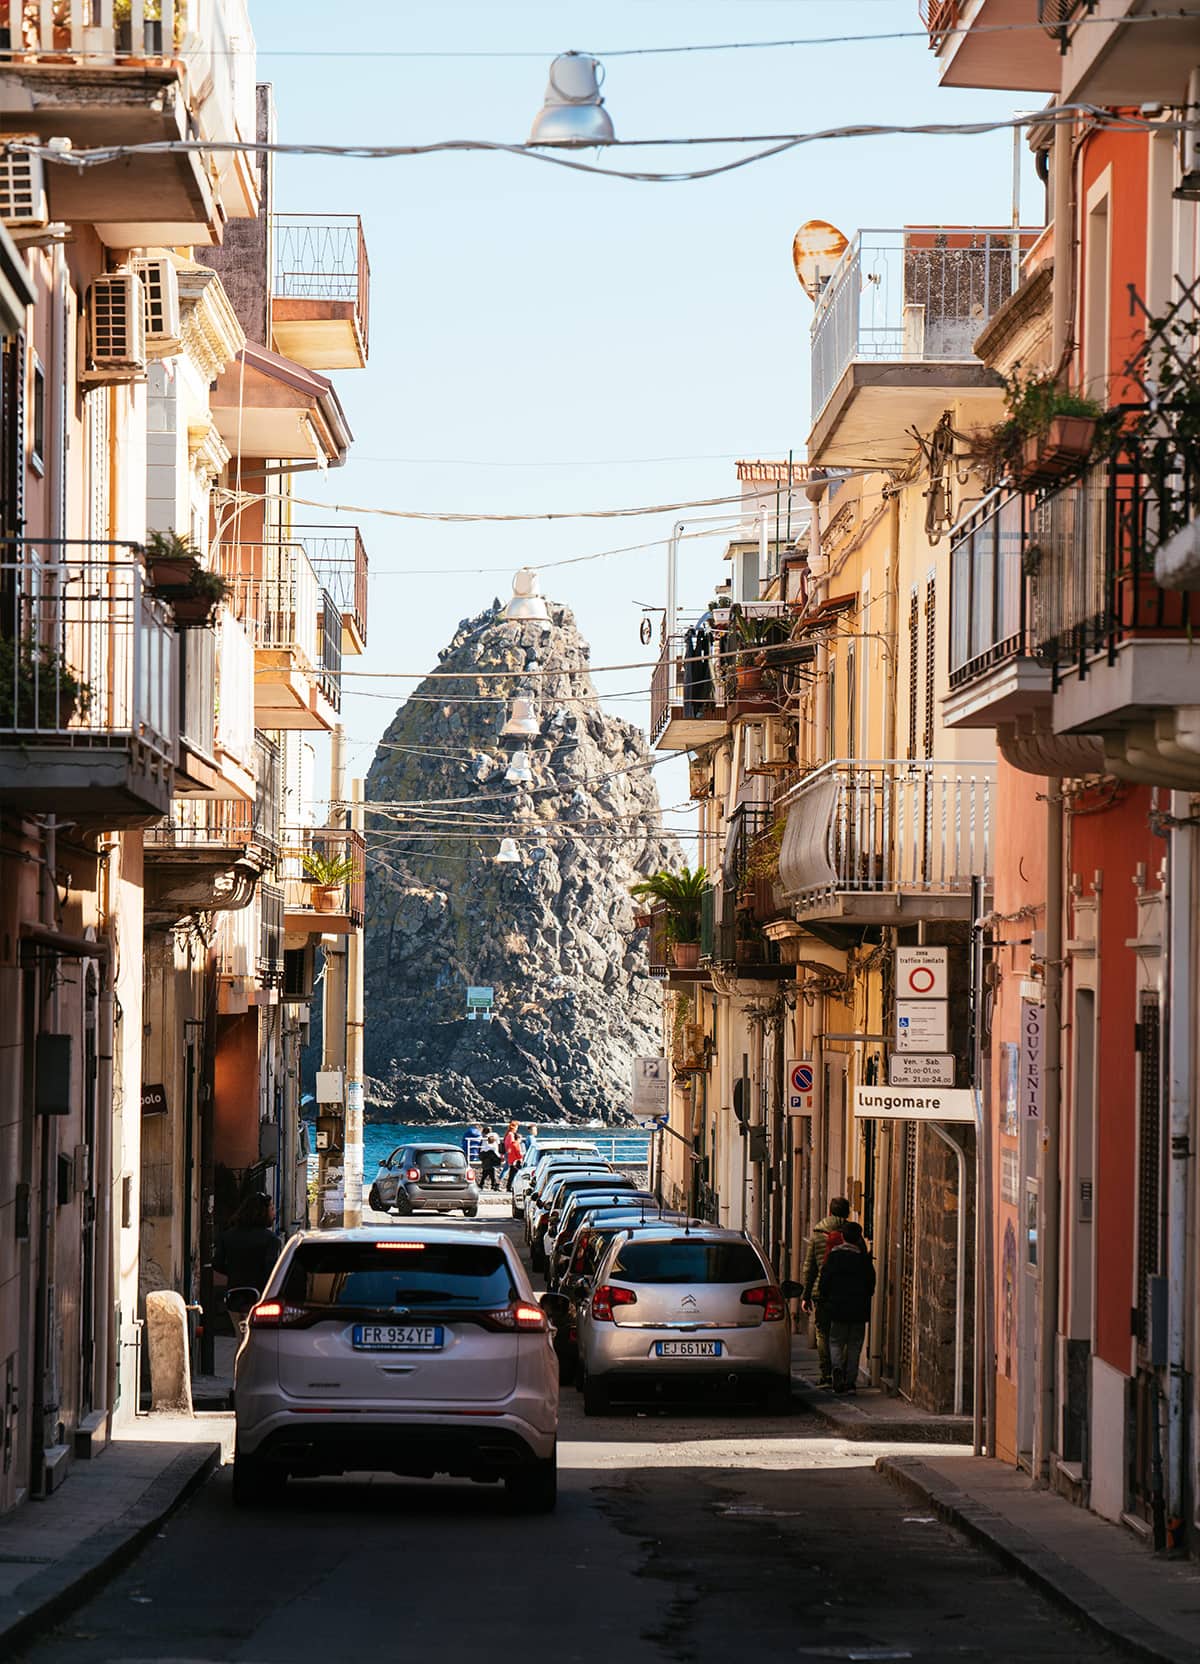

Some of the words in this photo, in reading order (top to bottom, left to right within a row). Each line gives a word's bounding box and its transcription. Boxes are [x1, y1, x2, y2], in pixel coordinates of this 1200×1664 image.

[1026, 1008, 1040, 1117] SOUVENIR
[859, 1093, 941, 1110] lungomare
[364, 1327, 381, 1343] FR
[663, 1343, 677, 1354] EJ
